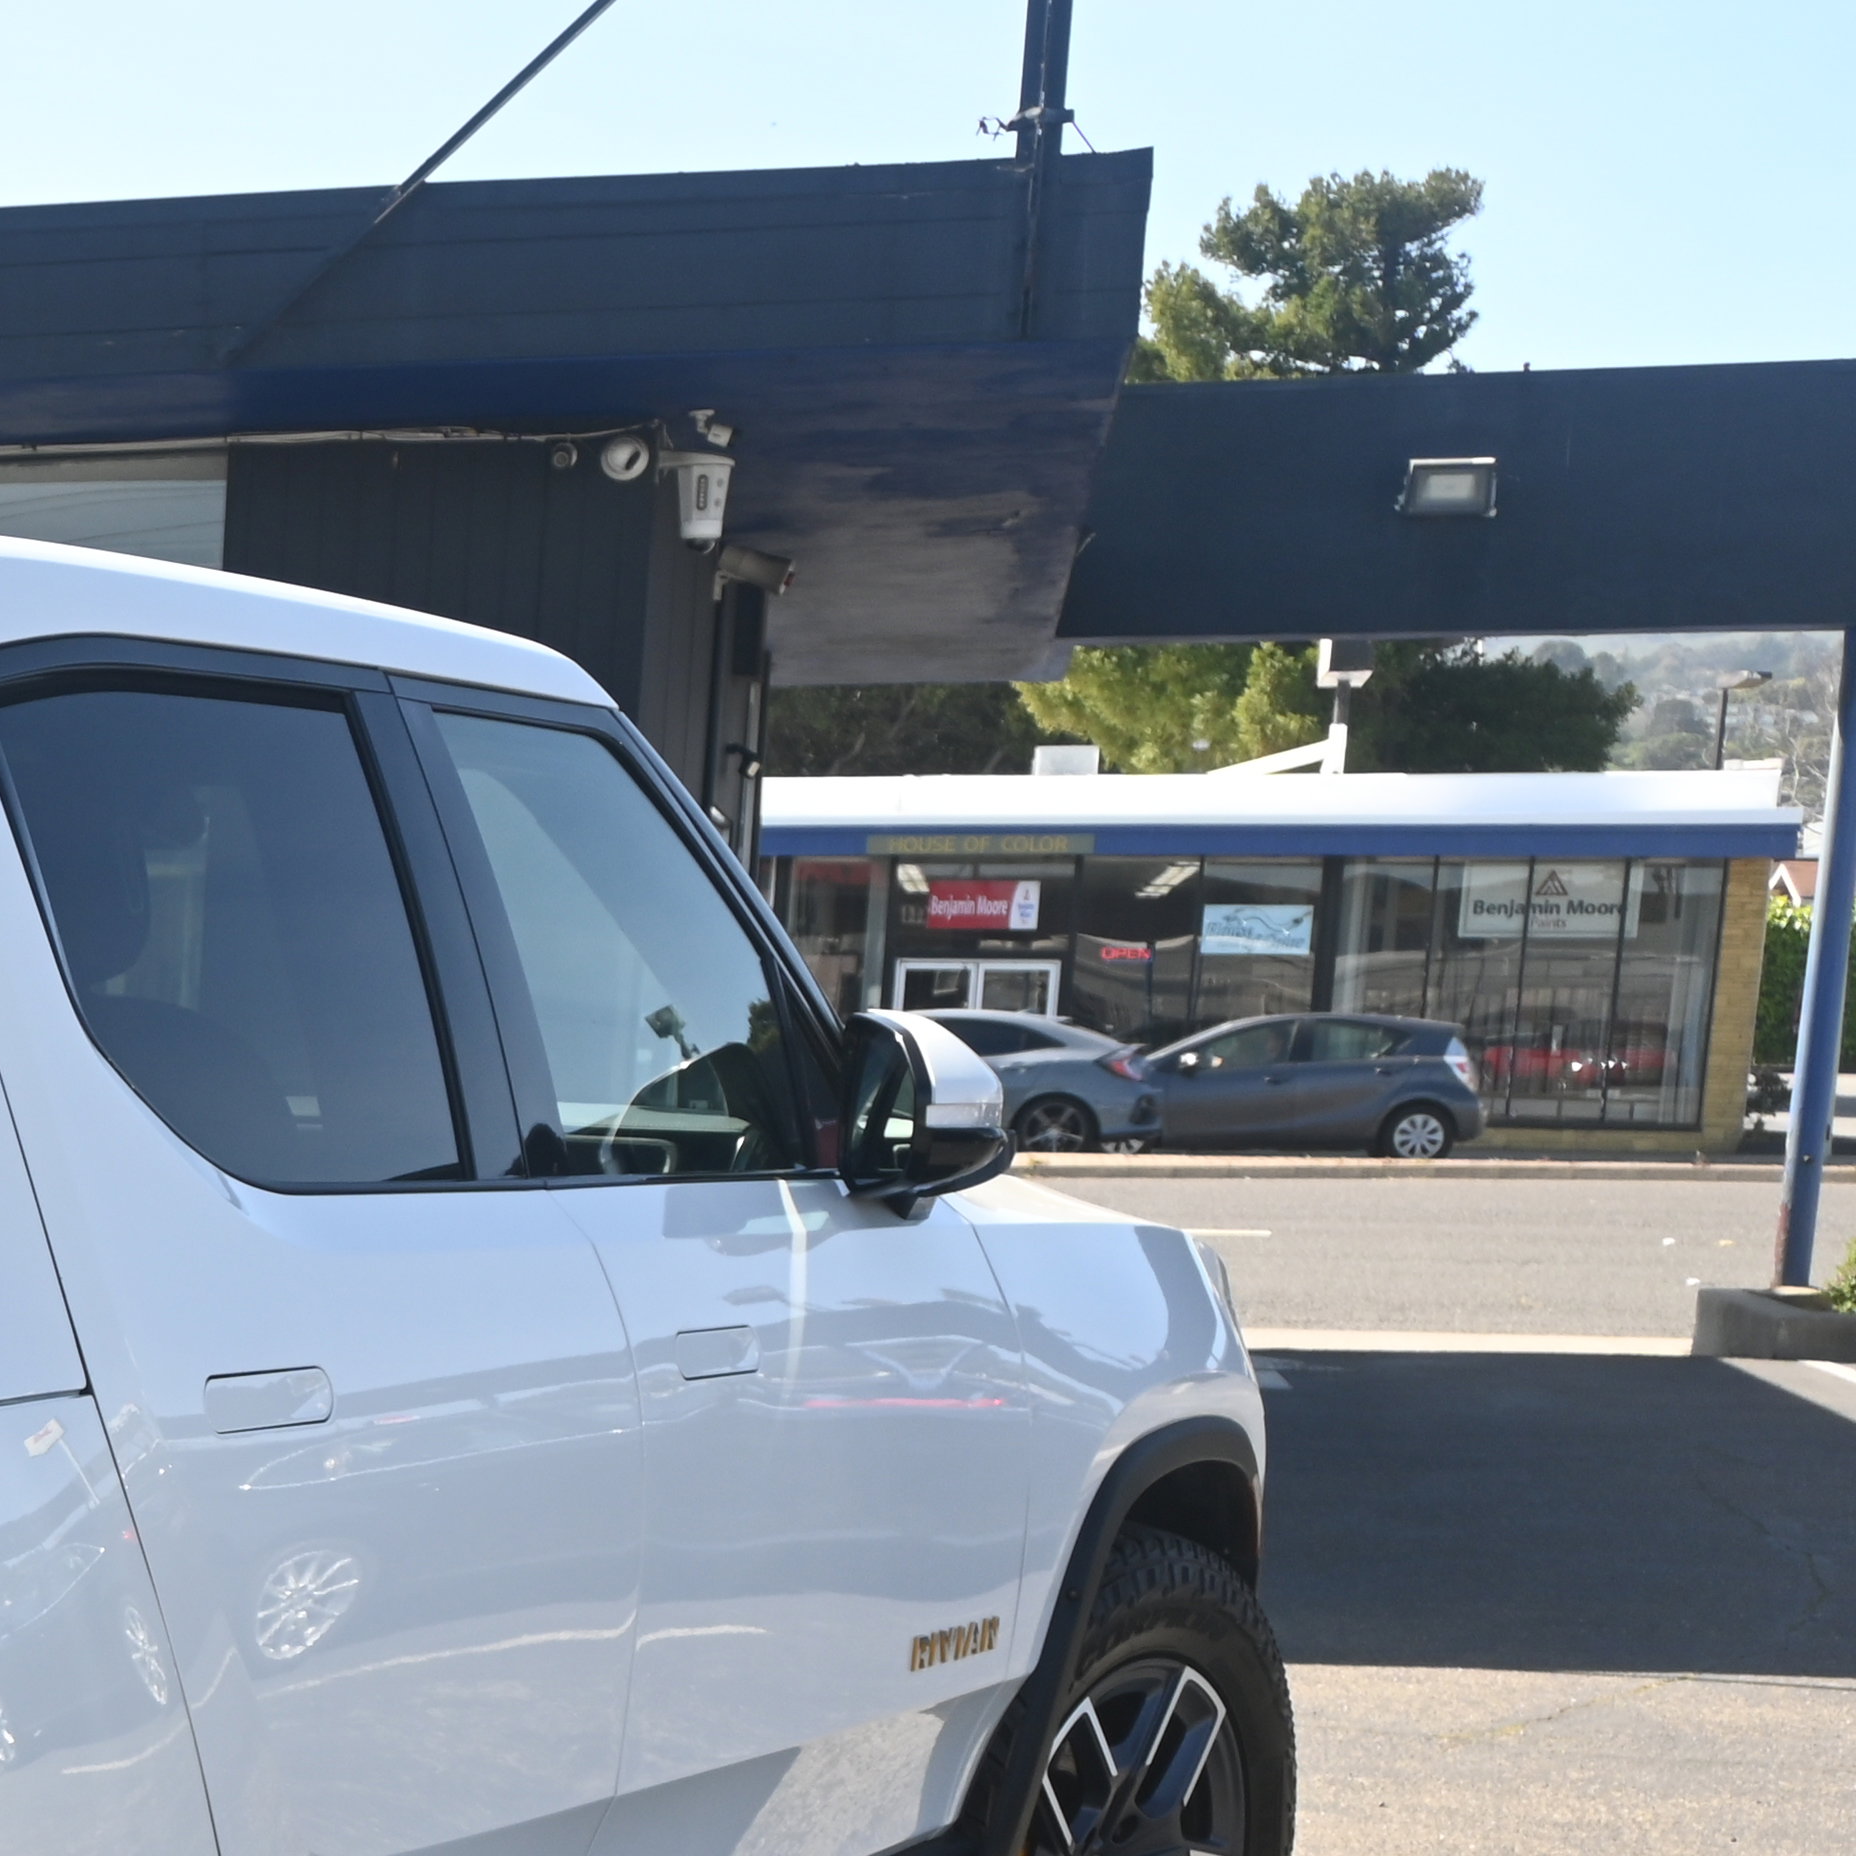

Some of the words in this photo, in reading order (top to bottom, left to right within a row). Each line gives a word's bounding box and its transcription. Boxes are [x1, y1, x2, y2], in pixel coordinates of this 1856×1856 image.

[890, 836, 956, 851] HOUSE
[965, 836, 990, 851] OF
[1001, 835, 1069, 851] COLOR
[931, 895, 975, 920] Benjamin
[977, 896, 1008, 916] Moore
[1473, 900, 1561, 919] Benjamin
[1101, 947, 1152, 960] OPEN
[910, 1616, 1000, 1672] RIVIAN
